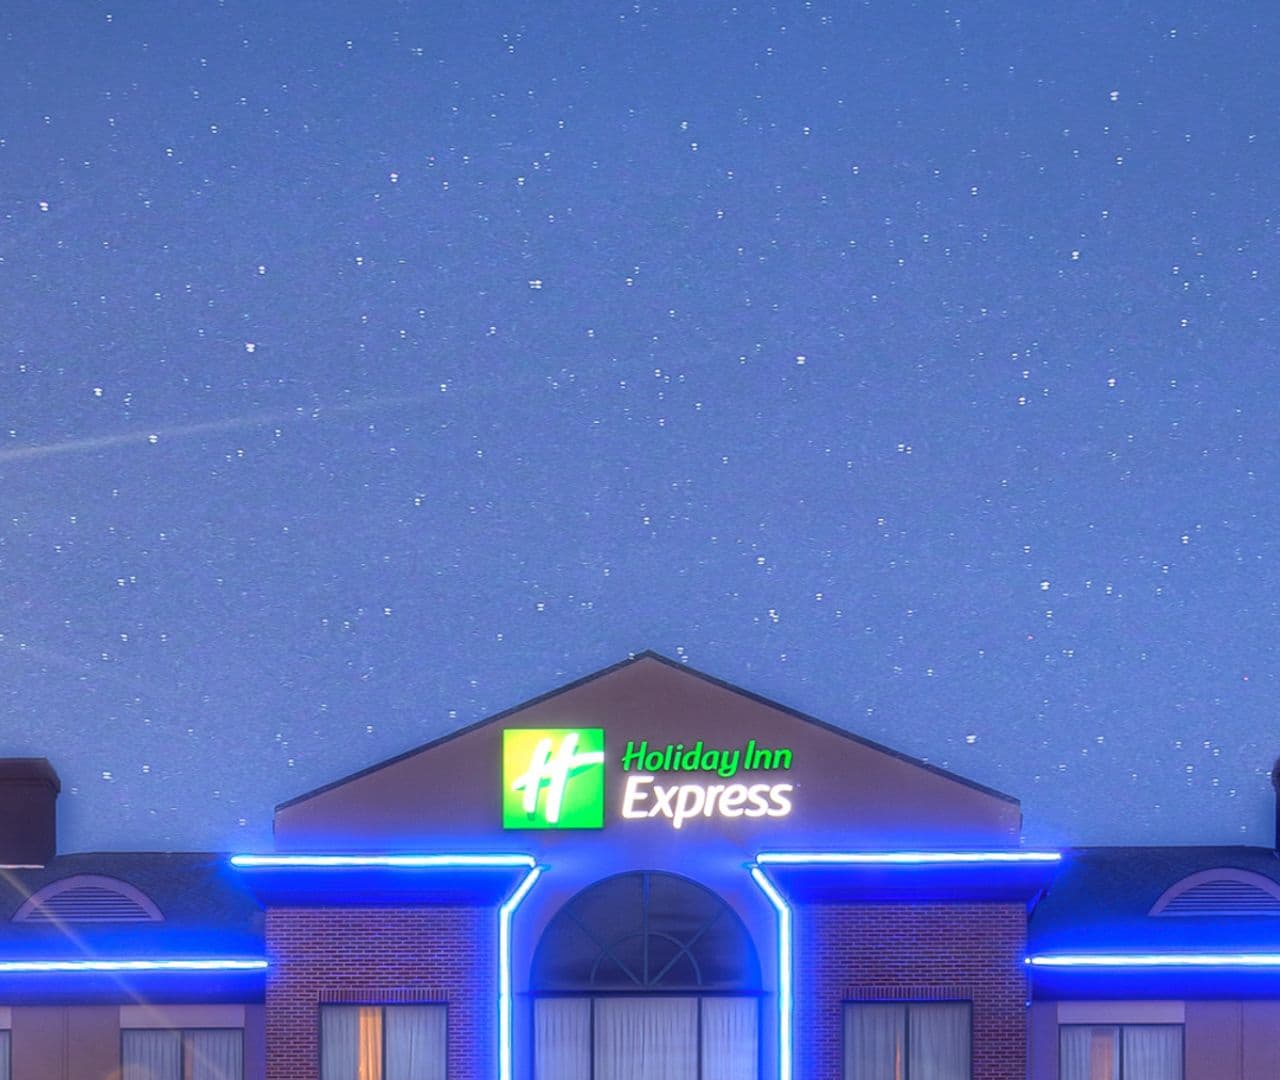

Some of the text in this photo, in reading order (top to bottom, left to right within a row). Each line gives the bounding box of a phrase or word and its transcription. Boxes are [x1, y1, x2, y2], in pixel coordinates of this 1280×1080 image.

[622, 740, 793, 777] Holiday Inn
[621, 775, 793, 829] Express
